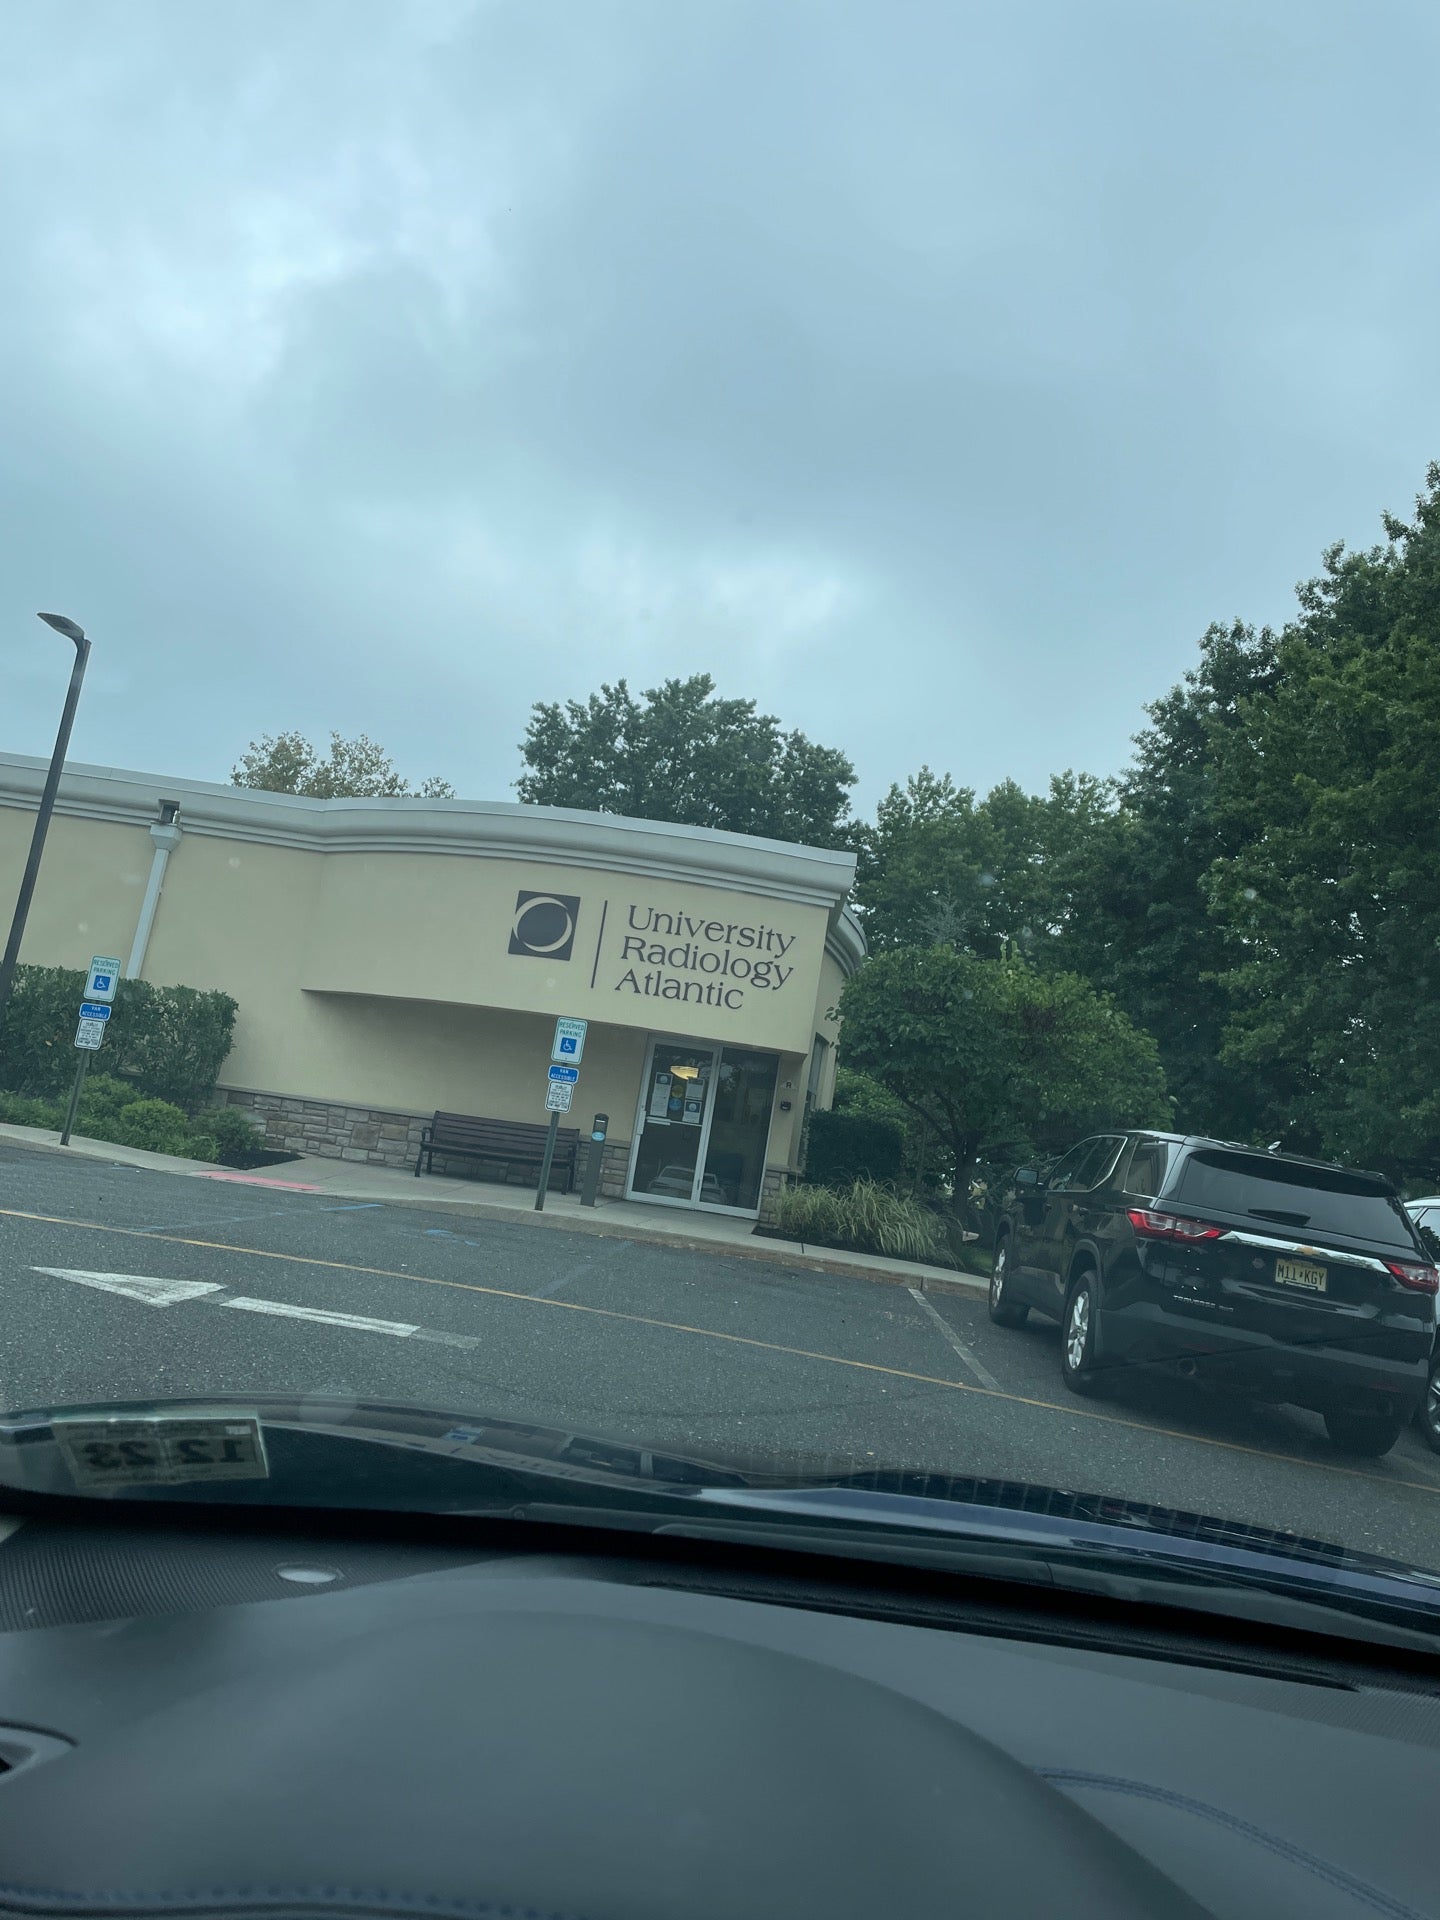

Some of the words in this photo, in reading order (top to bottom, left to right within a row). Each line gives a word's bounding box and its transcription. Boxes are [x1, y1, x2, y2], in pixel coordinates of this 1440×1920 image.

[627, 904, 796, 959] University
[93, 960, 119, 969] RESERVED
[620, 935, 794, 991] Radiology
[94, 967, 116, 976] PARKING
[614, 968, 744, 1010] Atlantic
[559, 1021, 585, 1031] RESERVED
[559, 1029, 582, 1038] PARKING
